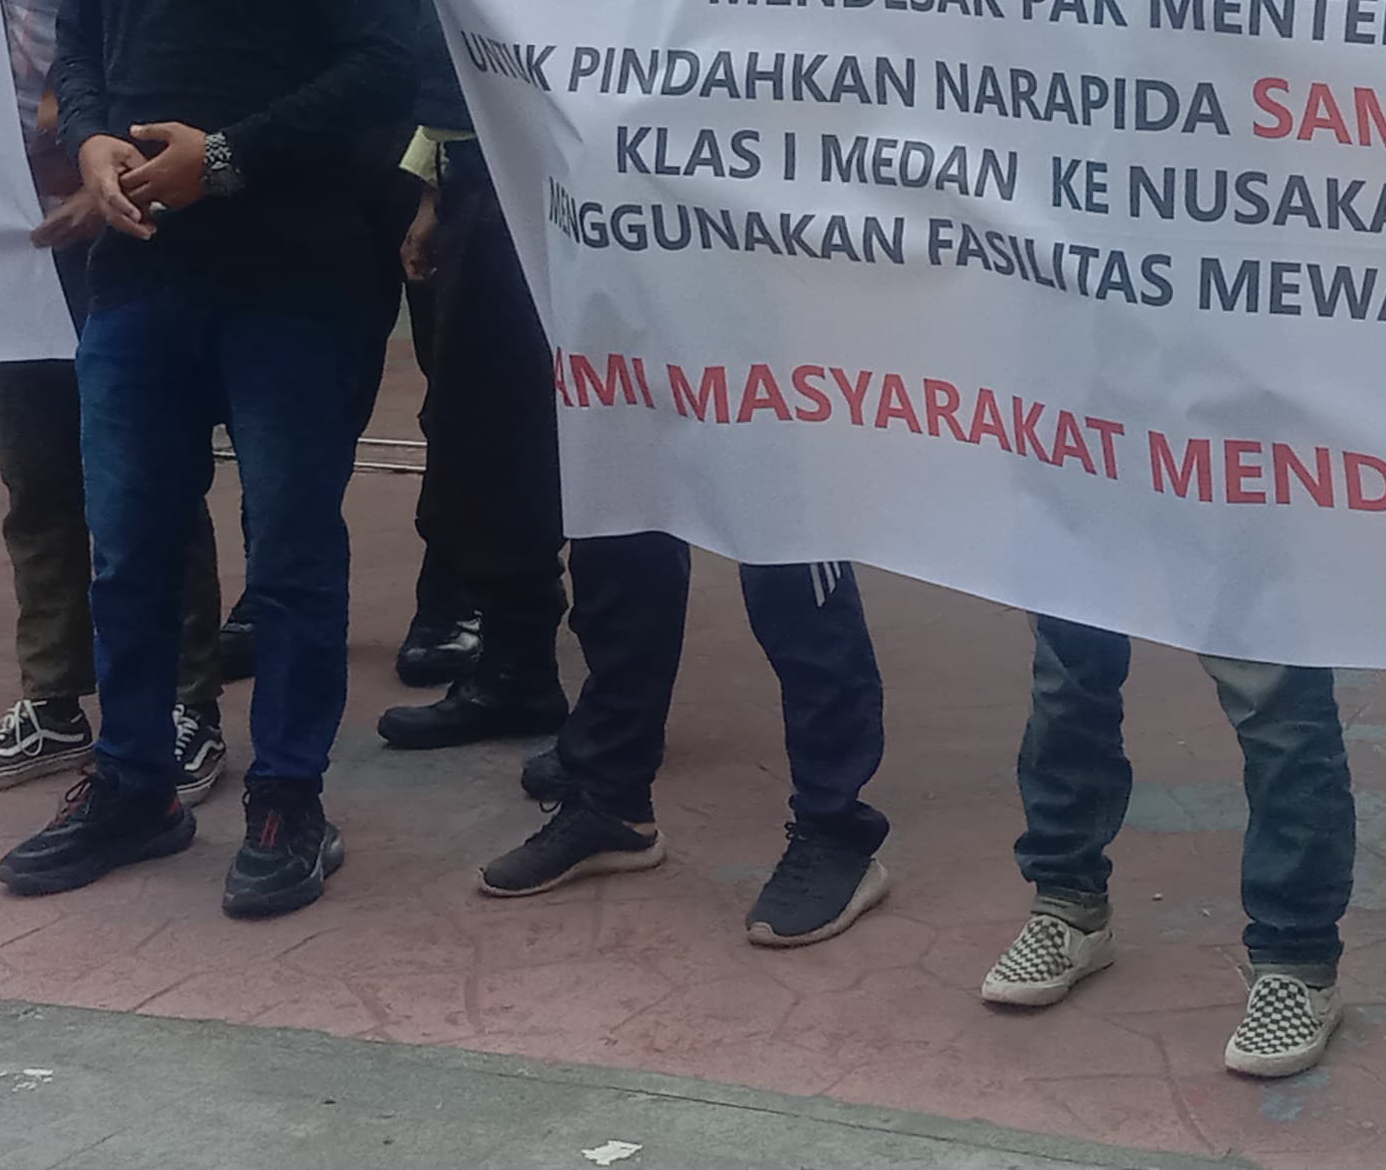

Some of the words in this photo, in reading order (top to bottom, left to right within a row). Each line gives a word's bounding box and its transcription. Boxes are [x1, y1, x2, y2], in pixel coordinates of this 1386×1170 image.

[460, 30, 557, 92] UNTUK
[568, 45, 914, 108] PINDAHKAN
[935, 61, 1230, 136] NARAPIDA
[617, 126, 760, 179] KLAS
[784, 132, 796, 180] I
[821, 133, 1018, 201] MEDAN
[1052, 156, 1109, 214] KE
[549, 176, 905, 264] MENGGUNAKAN
[928, 218, 1174, 307] FASILITAS
[554, 346, 656, 410] AMI
[666, 363, 1124, 480] MASYARAKAT
